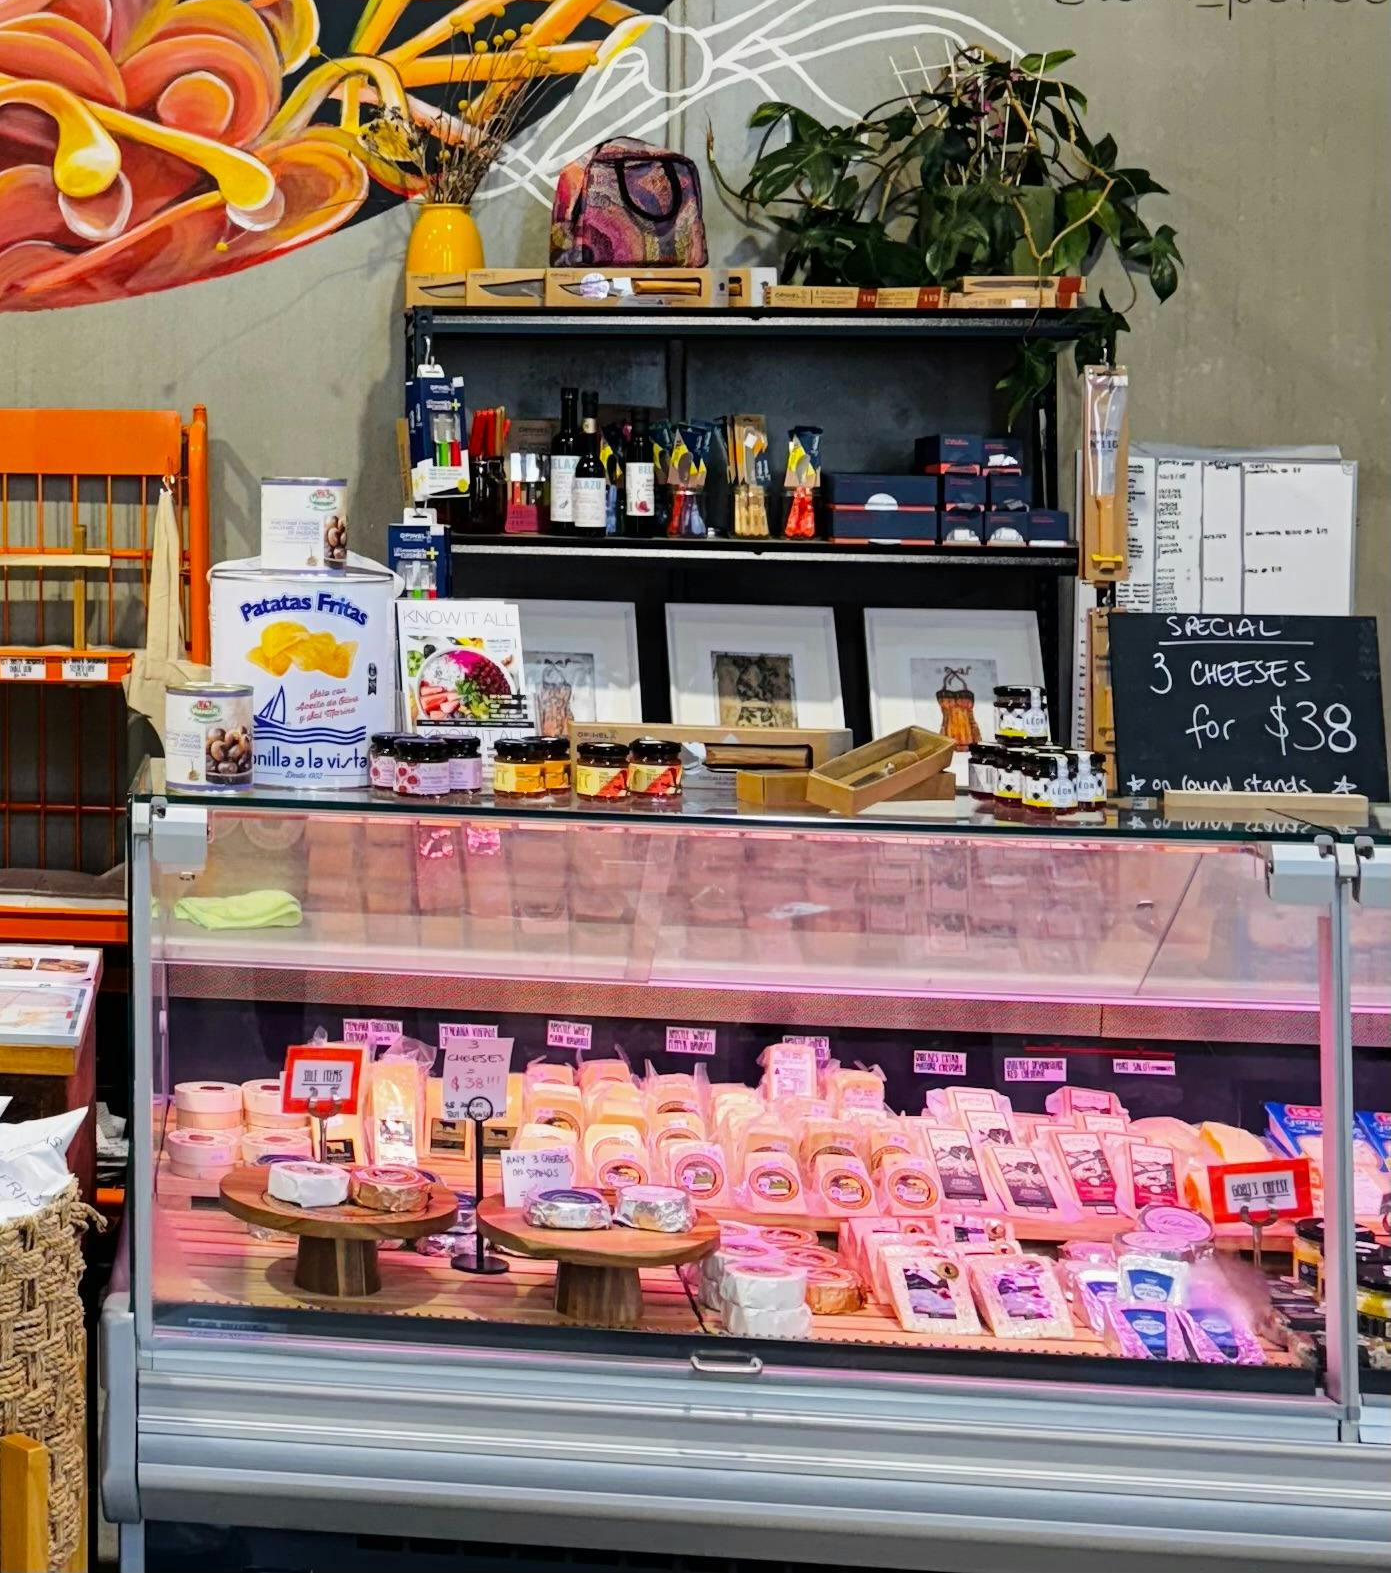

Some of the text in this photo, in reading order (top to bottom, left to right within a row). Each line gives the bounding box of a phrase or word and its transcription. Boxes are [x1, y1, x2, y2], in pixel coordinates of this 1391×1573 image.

[553, 458, 577, 469] ELAZ
[240, 592, 368, 626] Patatas Fritas
[403, 610, 461, 624] KNOW
[483, 612, 517, 626] ALL
[1166, 616, 1282, 637] SPECIAL
[1150, 652, 1312, 694] 3 CHEESES
[1185, 695, 1357, 756] for $38
[295, 757, 305, 768] a
[308, 747, 323, 769] la
[327, 748, 368, 769] vista
[1152, 778, 1170, 791] on
[1243, 773, 1312, 794] stands
[468, 1040, 479, 1049] 3
[447, 1054, 505, 1063] CHEESES
[323, 1070, 343, 1082] ITEMS
[506, 1156, 525, 1164] ANY
[1262, 1179, 1289, 1194] CHEESE
